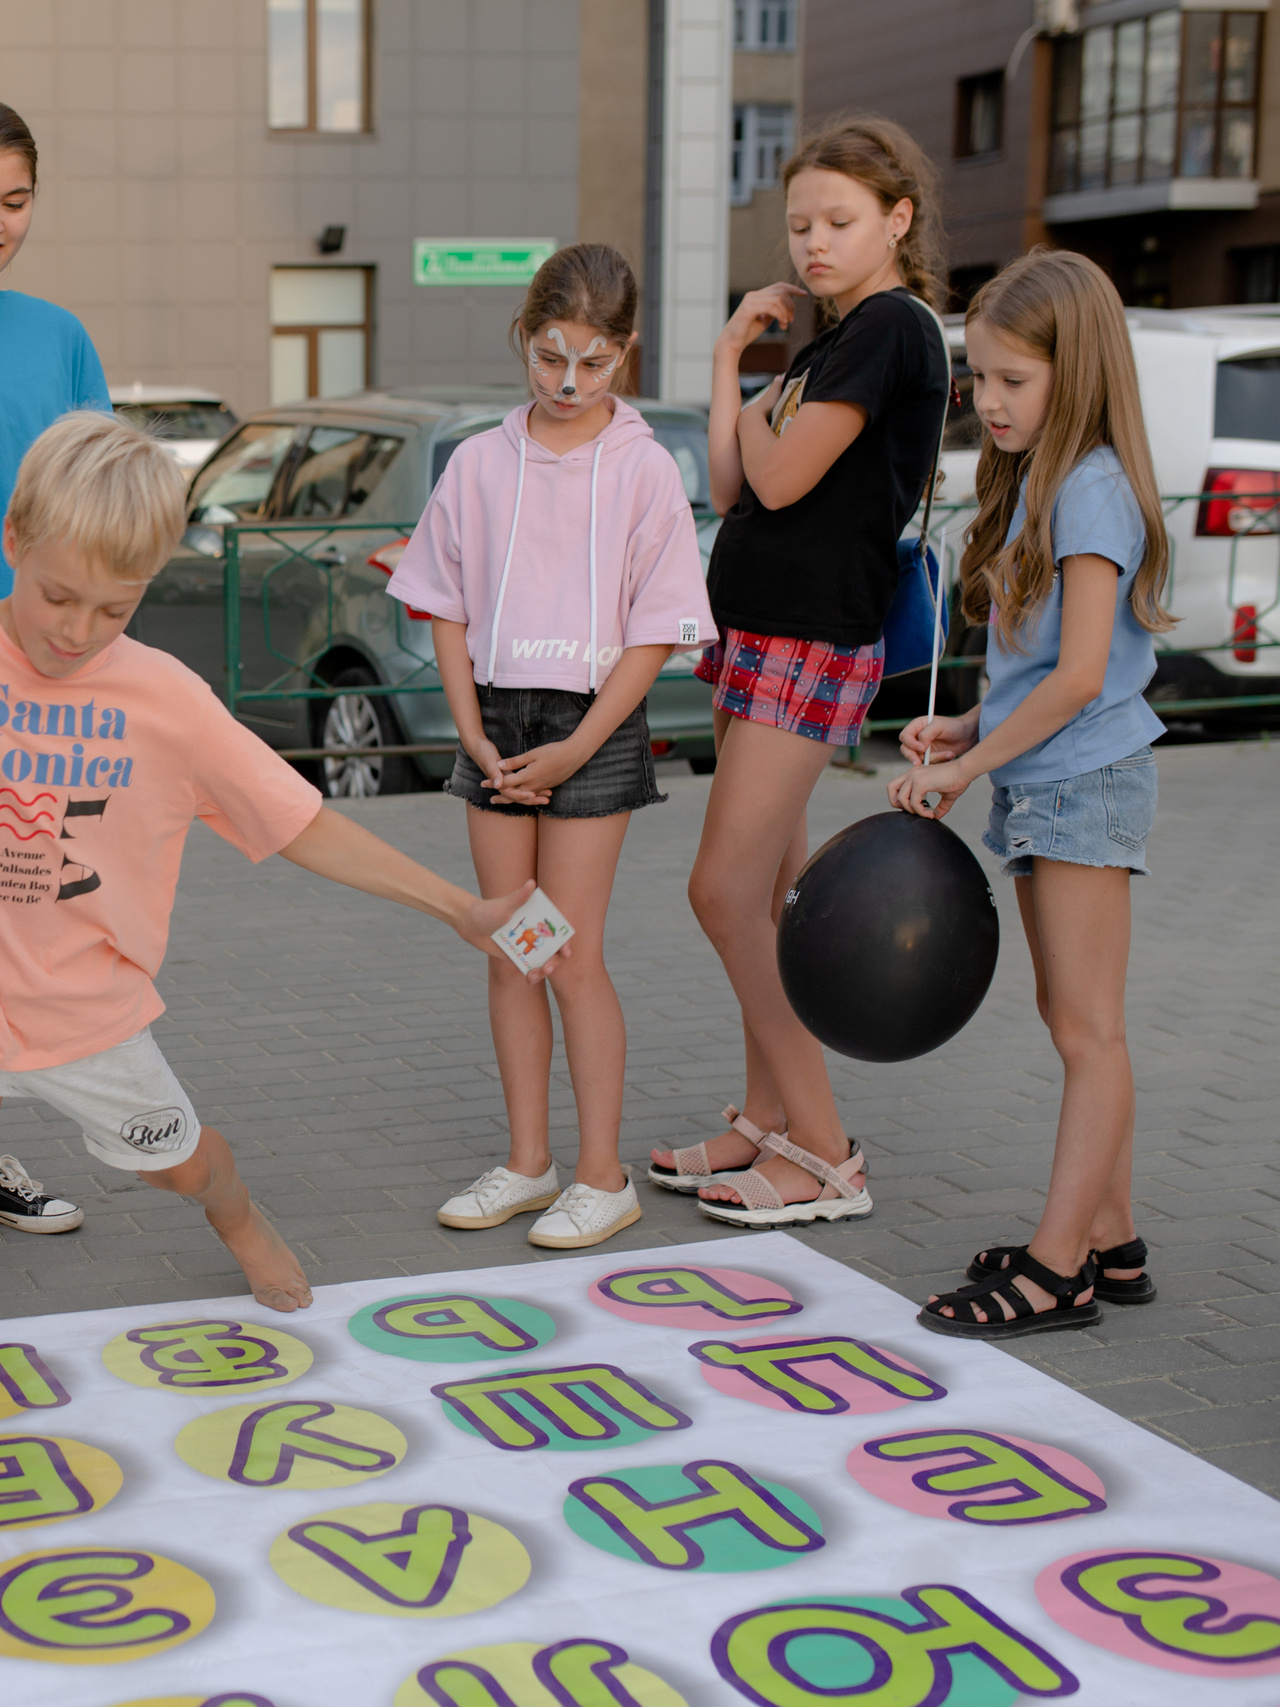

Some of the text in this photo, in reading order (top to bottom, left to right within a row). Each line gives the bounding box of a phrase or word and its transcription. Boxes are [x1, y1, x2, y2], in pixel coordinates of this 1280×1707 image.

[682, 633, 696, 642] IT!
[511, 638, 579, 660] WITH
[1, 847, 46, 860] Avenue
[29, 881, 53, 892] Bay
[12, 894, 24, 904] to
[25, 894, 42, 905] Be
